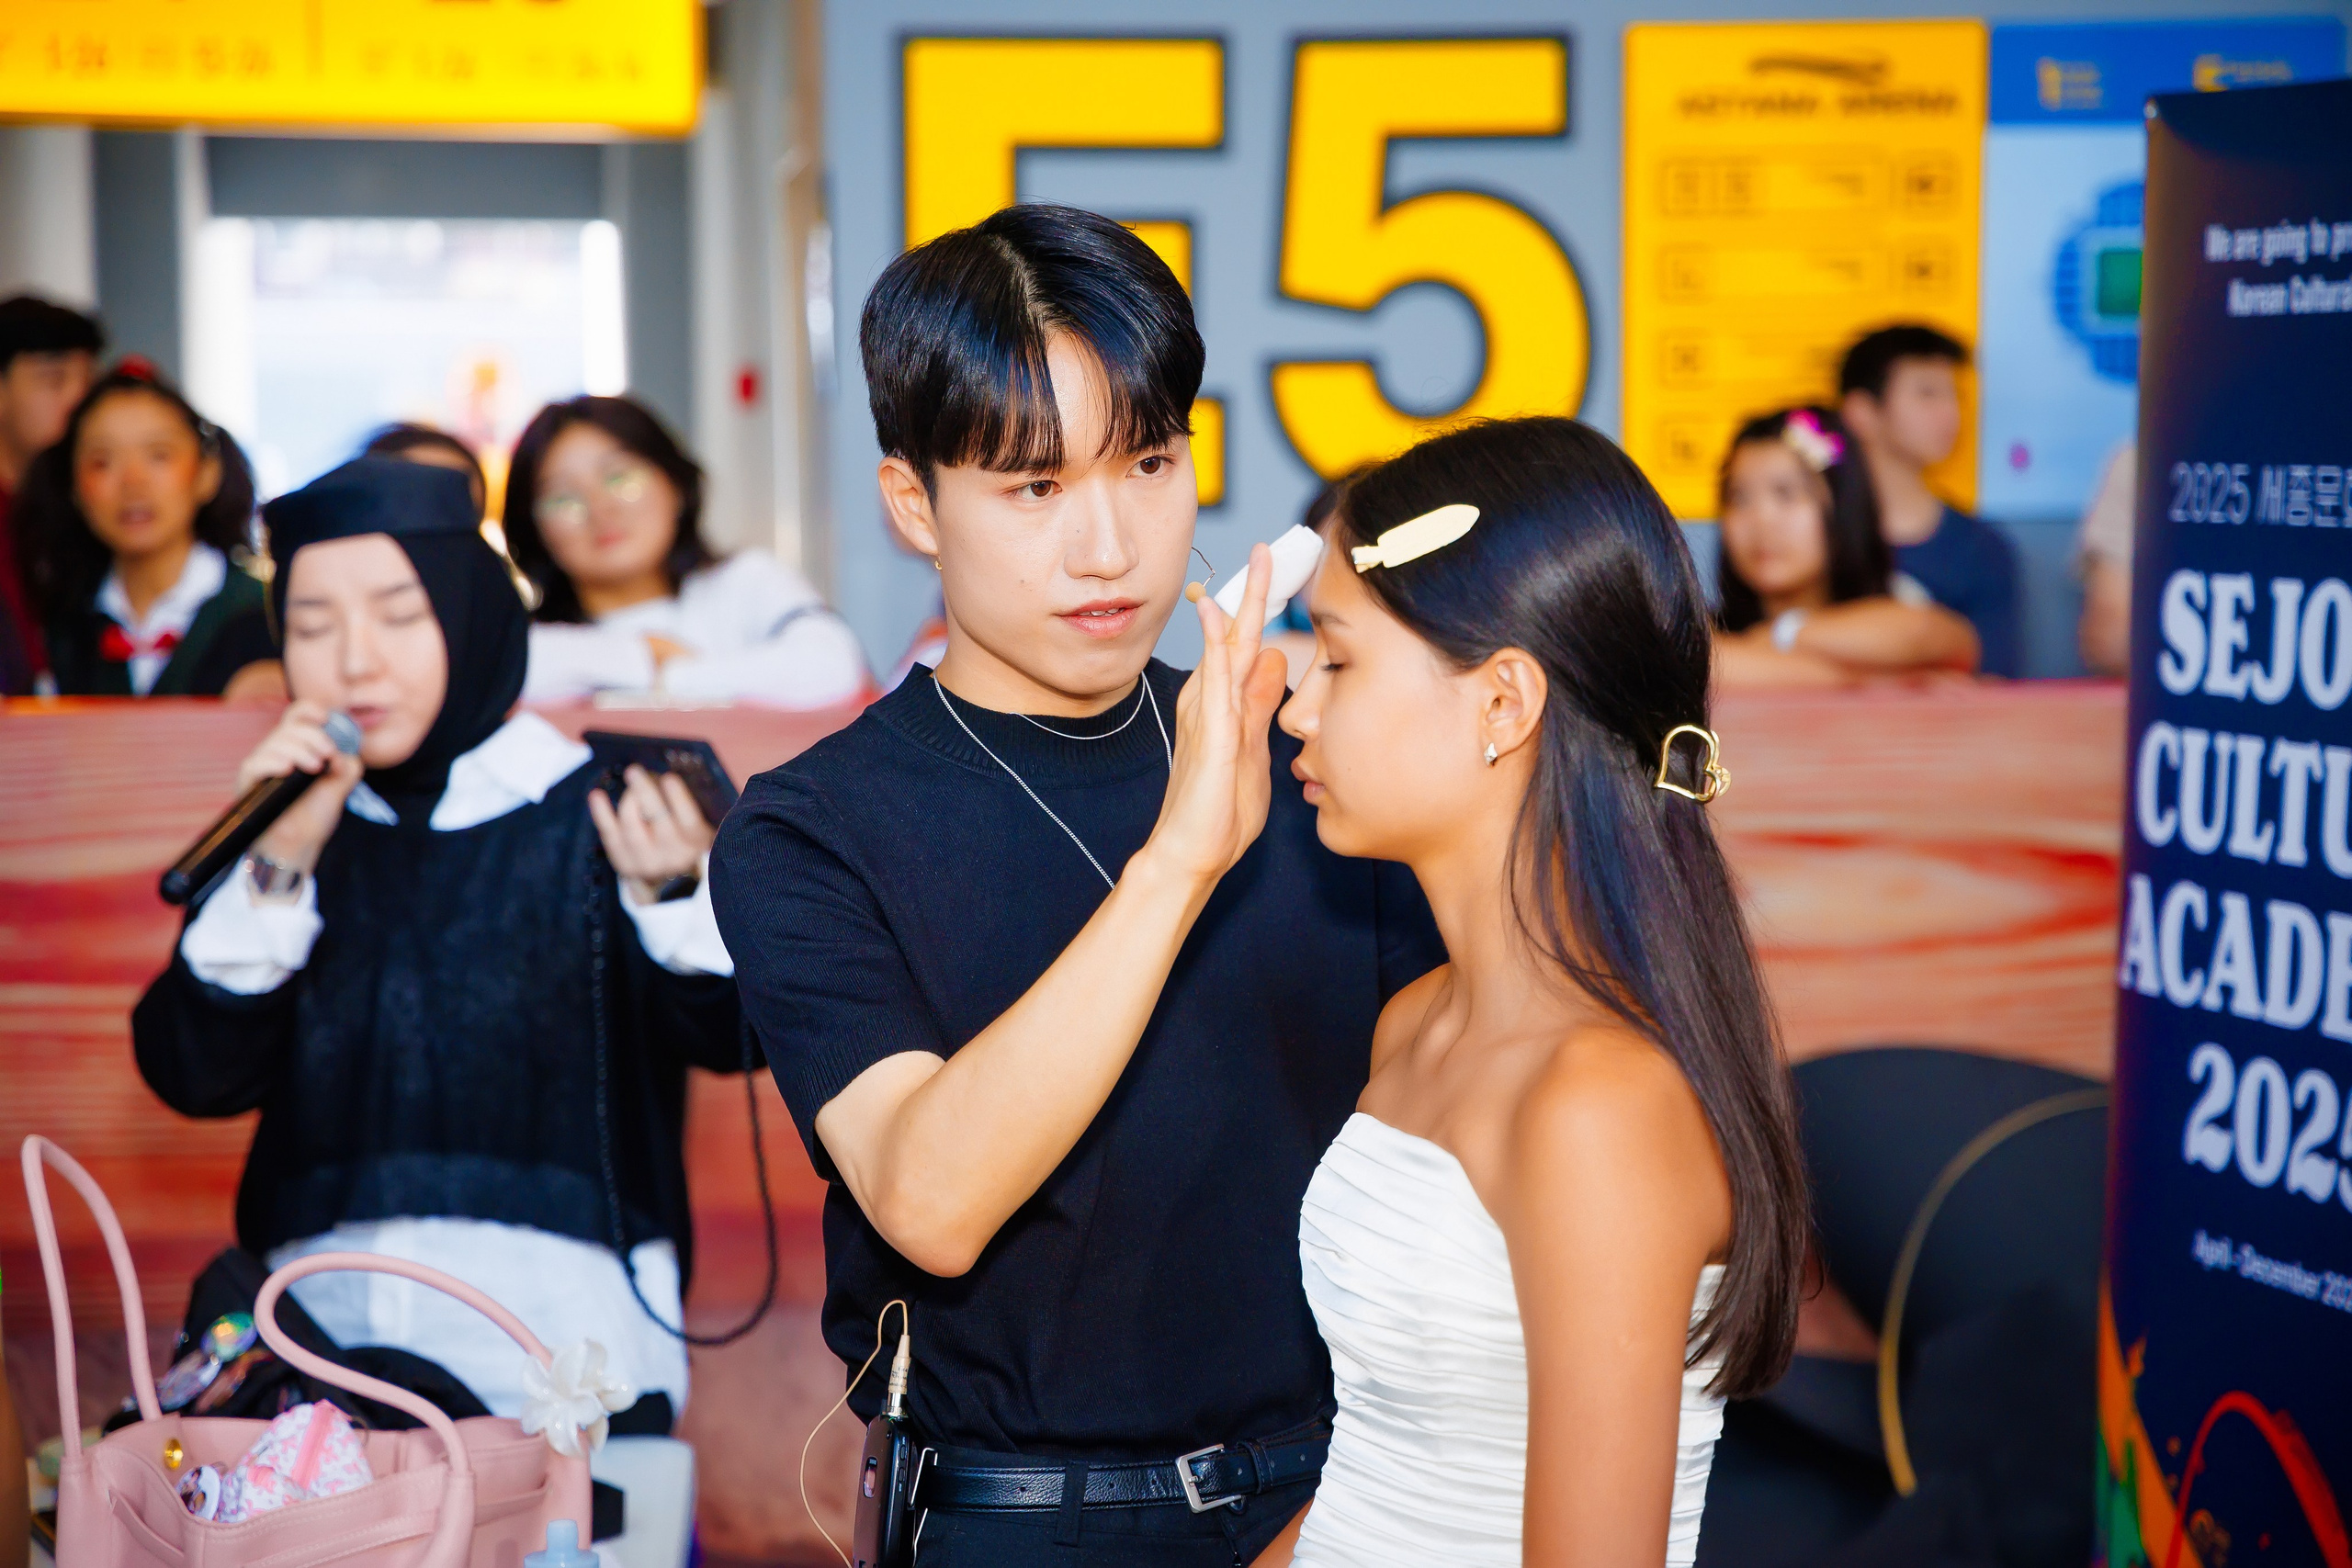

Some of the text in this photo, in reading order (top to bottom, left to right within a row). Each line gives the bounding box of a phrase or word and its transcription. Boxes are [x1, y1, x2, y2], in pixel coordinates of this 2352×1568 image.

[2168, 462, 2251, 525] 2025
[2156, 568, 2352, 712] SEJO
[2181, 1042, 2352, 1214] 202
